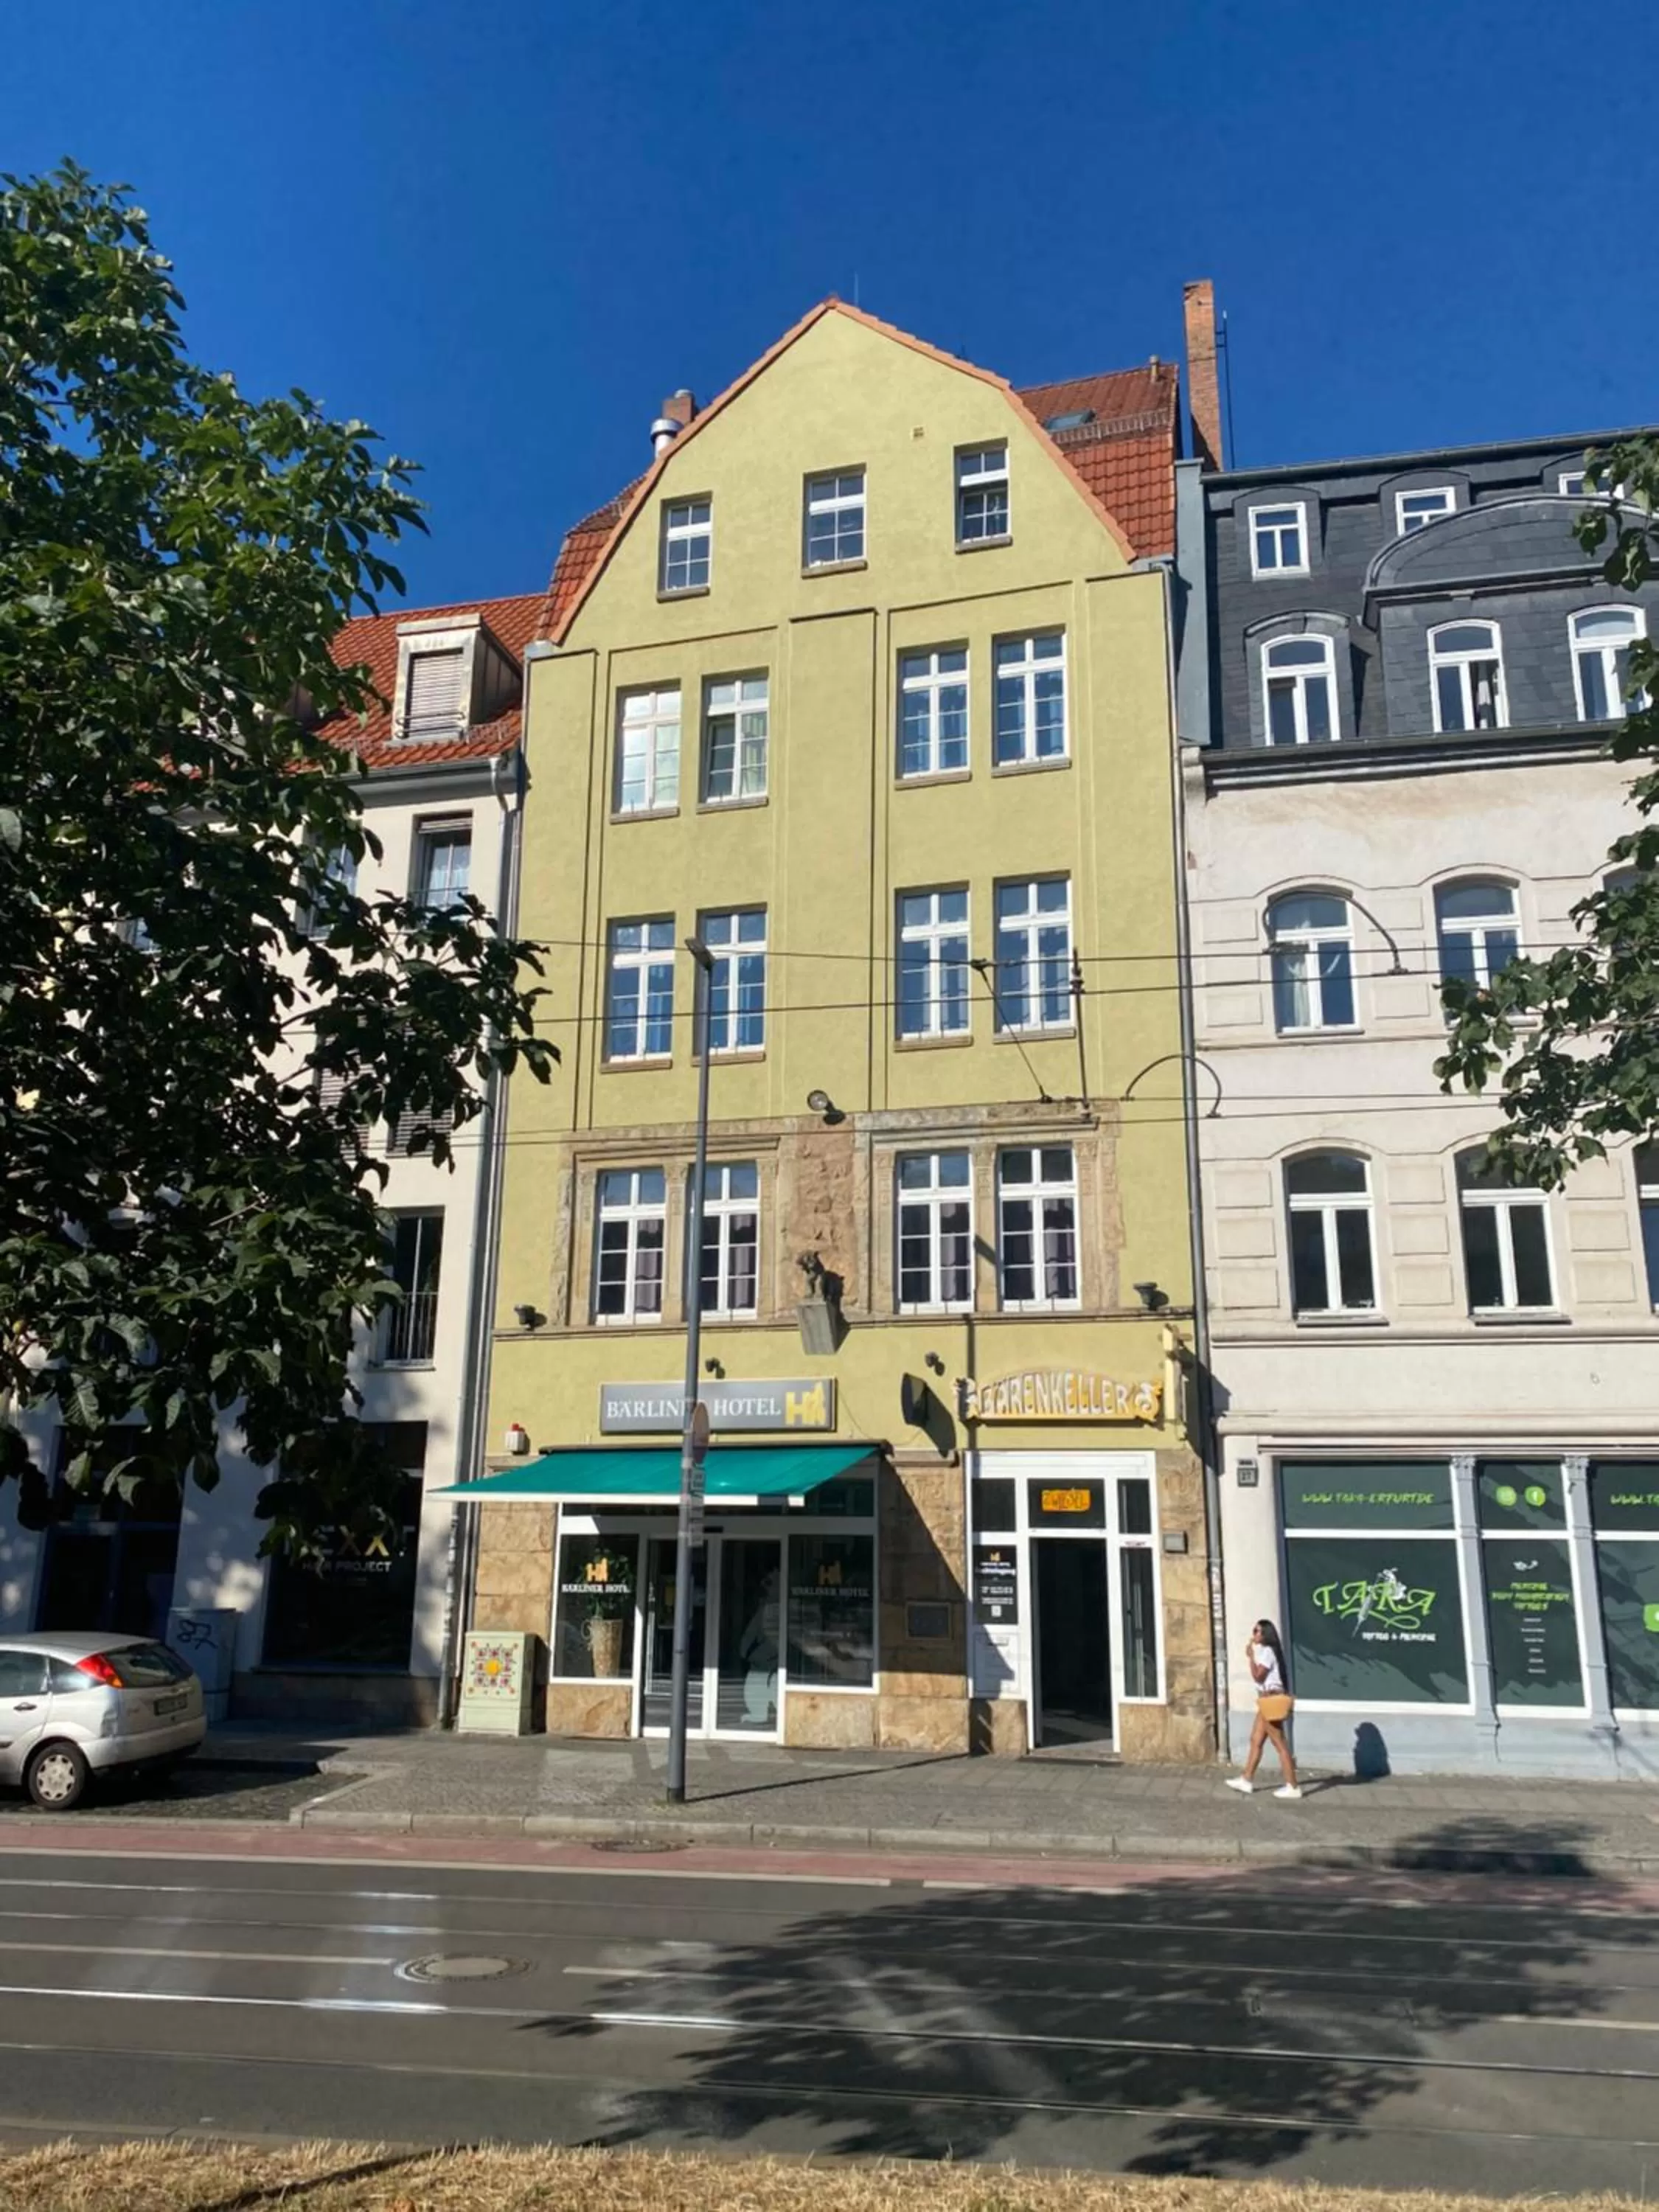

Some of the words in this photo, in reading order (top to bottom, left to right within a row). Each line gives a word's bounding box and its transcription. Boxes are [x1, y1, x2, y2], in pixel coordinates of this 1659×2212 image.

[606, 1397, 700, 1419] BÄRLIN
[713, 1397, 782, 1416] HOTEL
[979, 1371, 1128, 1415] BÄRENKELLER
[1312, 1580, 1436, 1615] TARA
